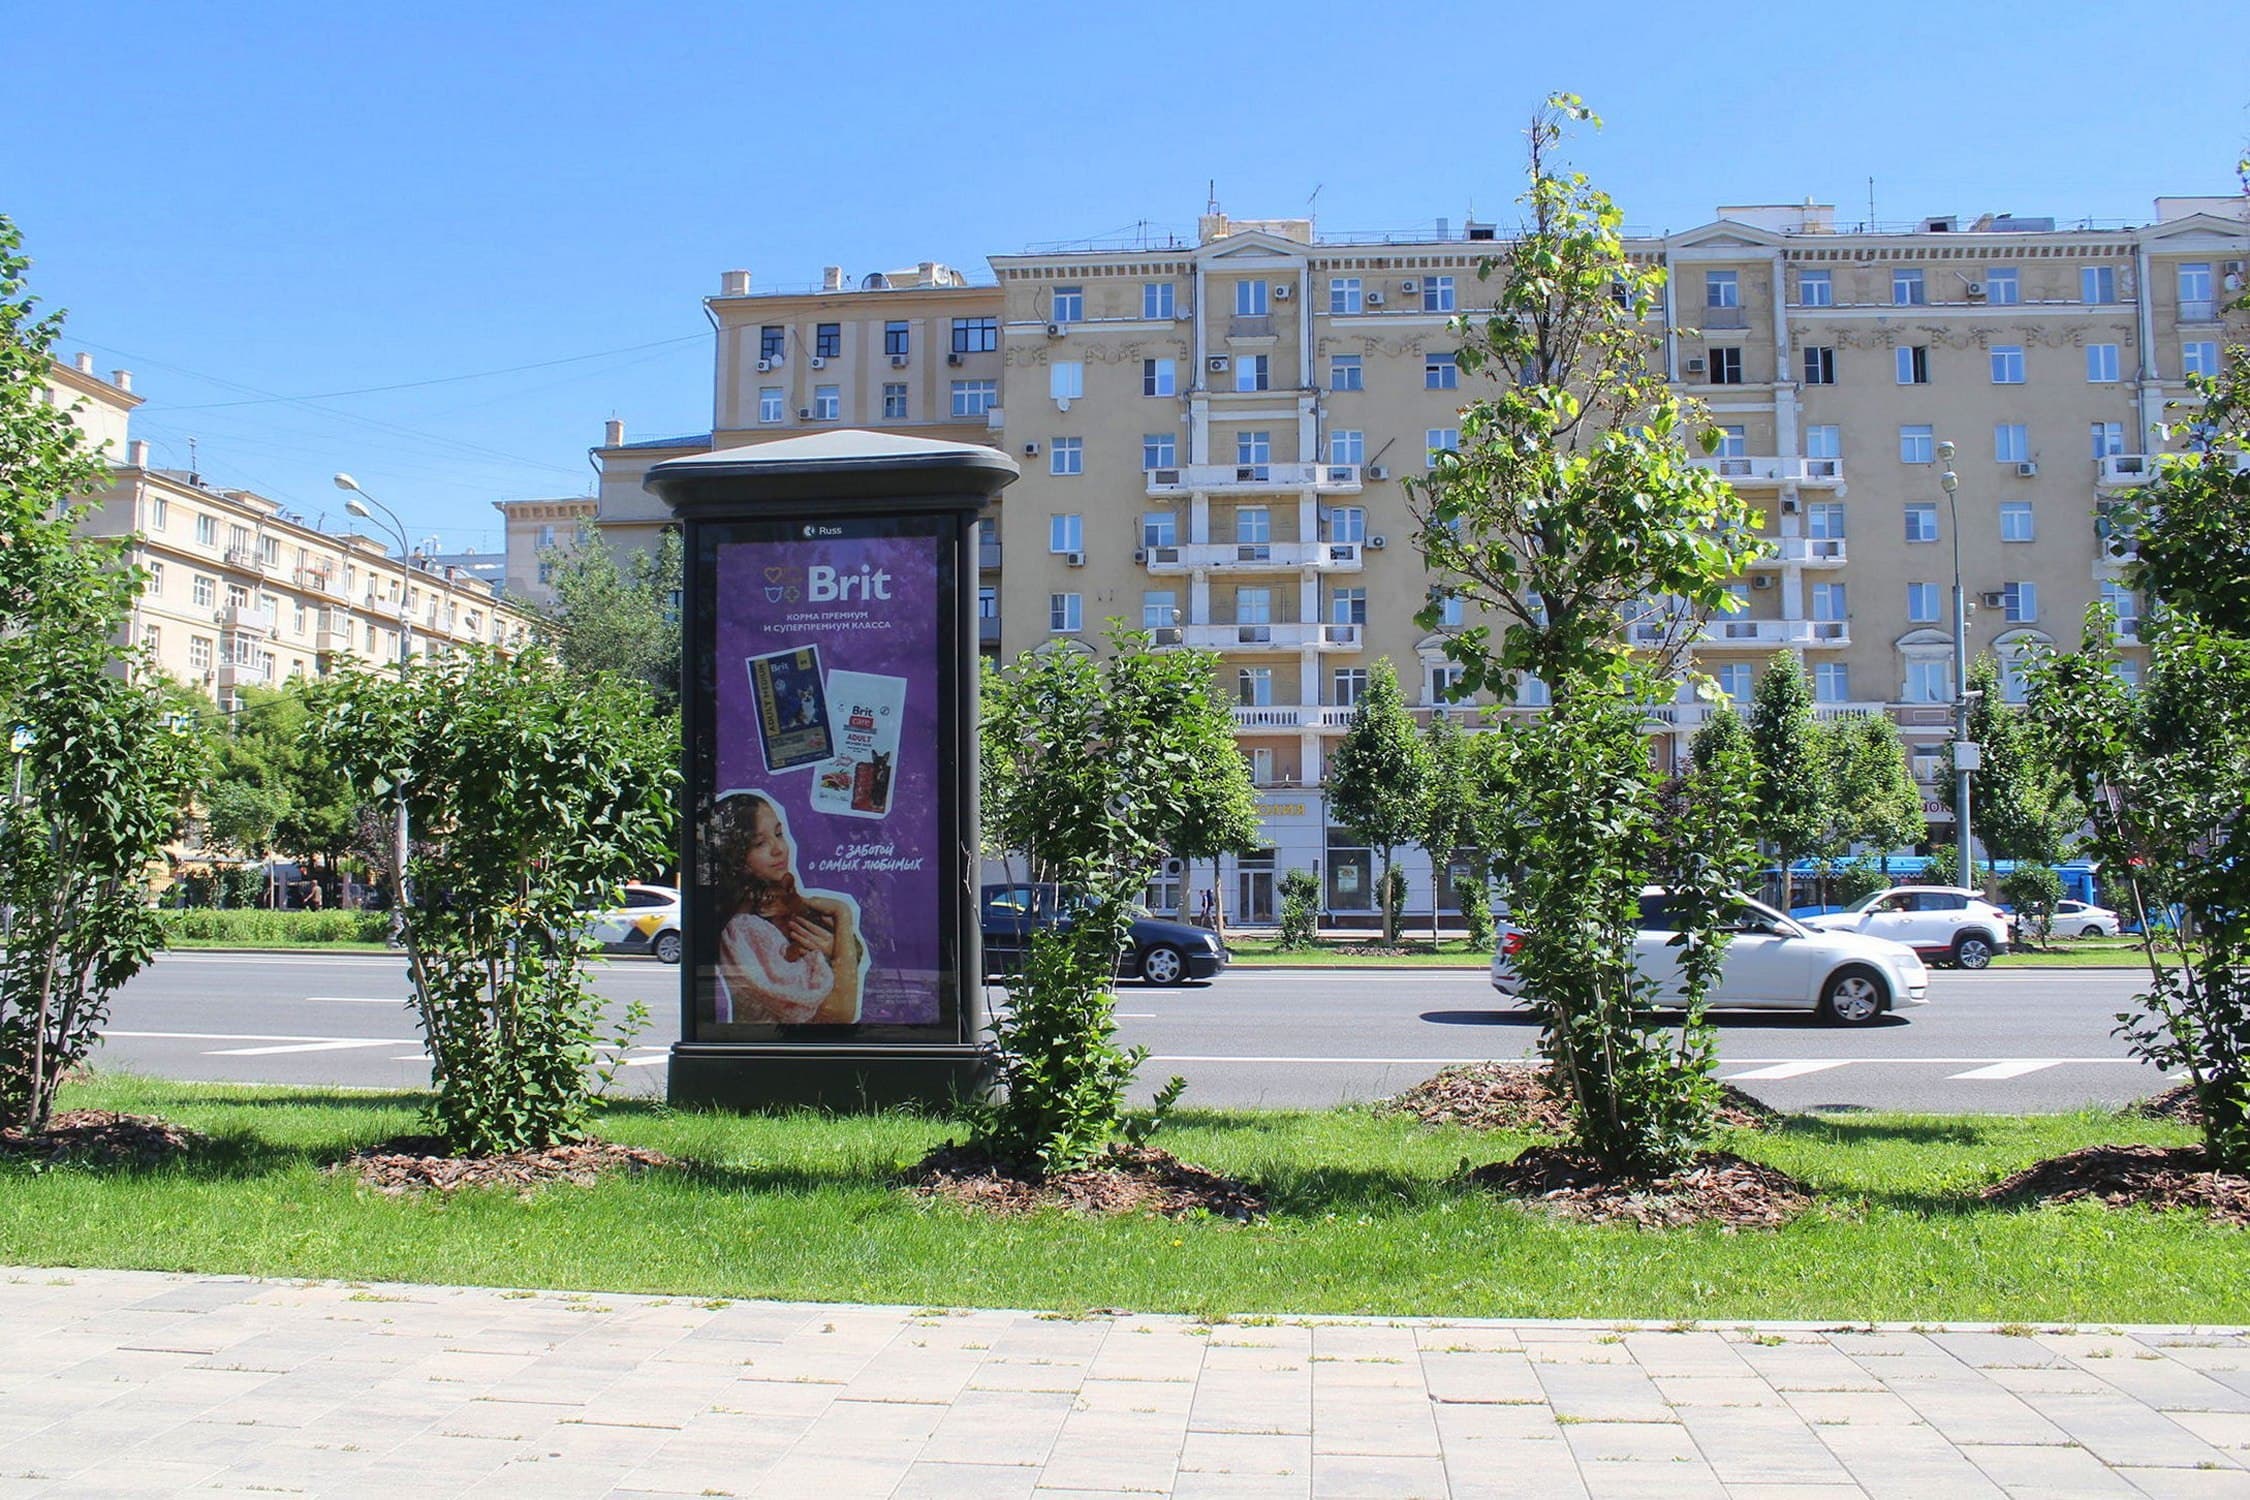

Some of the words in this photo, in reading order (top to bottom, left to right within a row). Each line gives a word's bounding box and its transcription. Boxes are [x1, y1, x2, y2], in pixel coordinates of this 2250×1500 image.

[819, 527, 842, 535] Russ
[808, 564, 892, 602] Brit
[787, 613, 819, 621] КОРМА
[821, 611, 869, 620] ПРЕМИУМ
[773, 621, 850, 633] СУПЕРПРЕМИУМ
[852, 621, 892, 630] КЛАССА
[770, 662, 789, 673] Brit
[852, 705, 873, 717] Brit
[847, 733, 873, 743] ADULT
[819, 858, 860, 872] САМЫХ
[862, 858, 924, 872] ЛЮБИМЫХ
